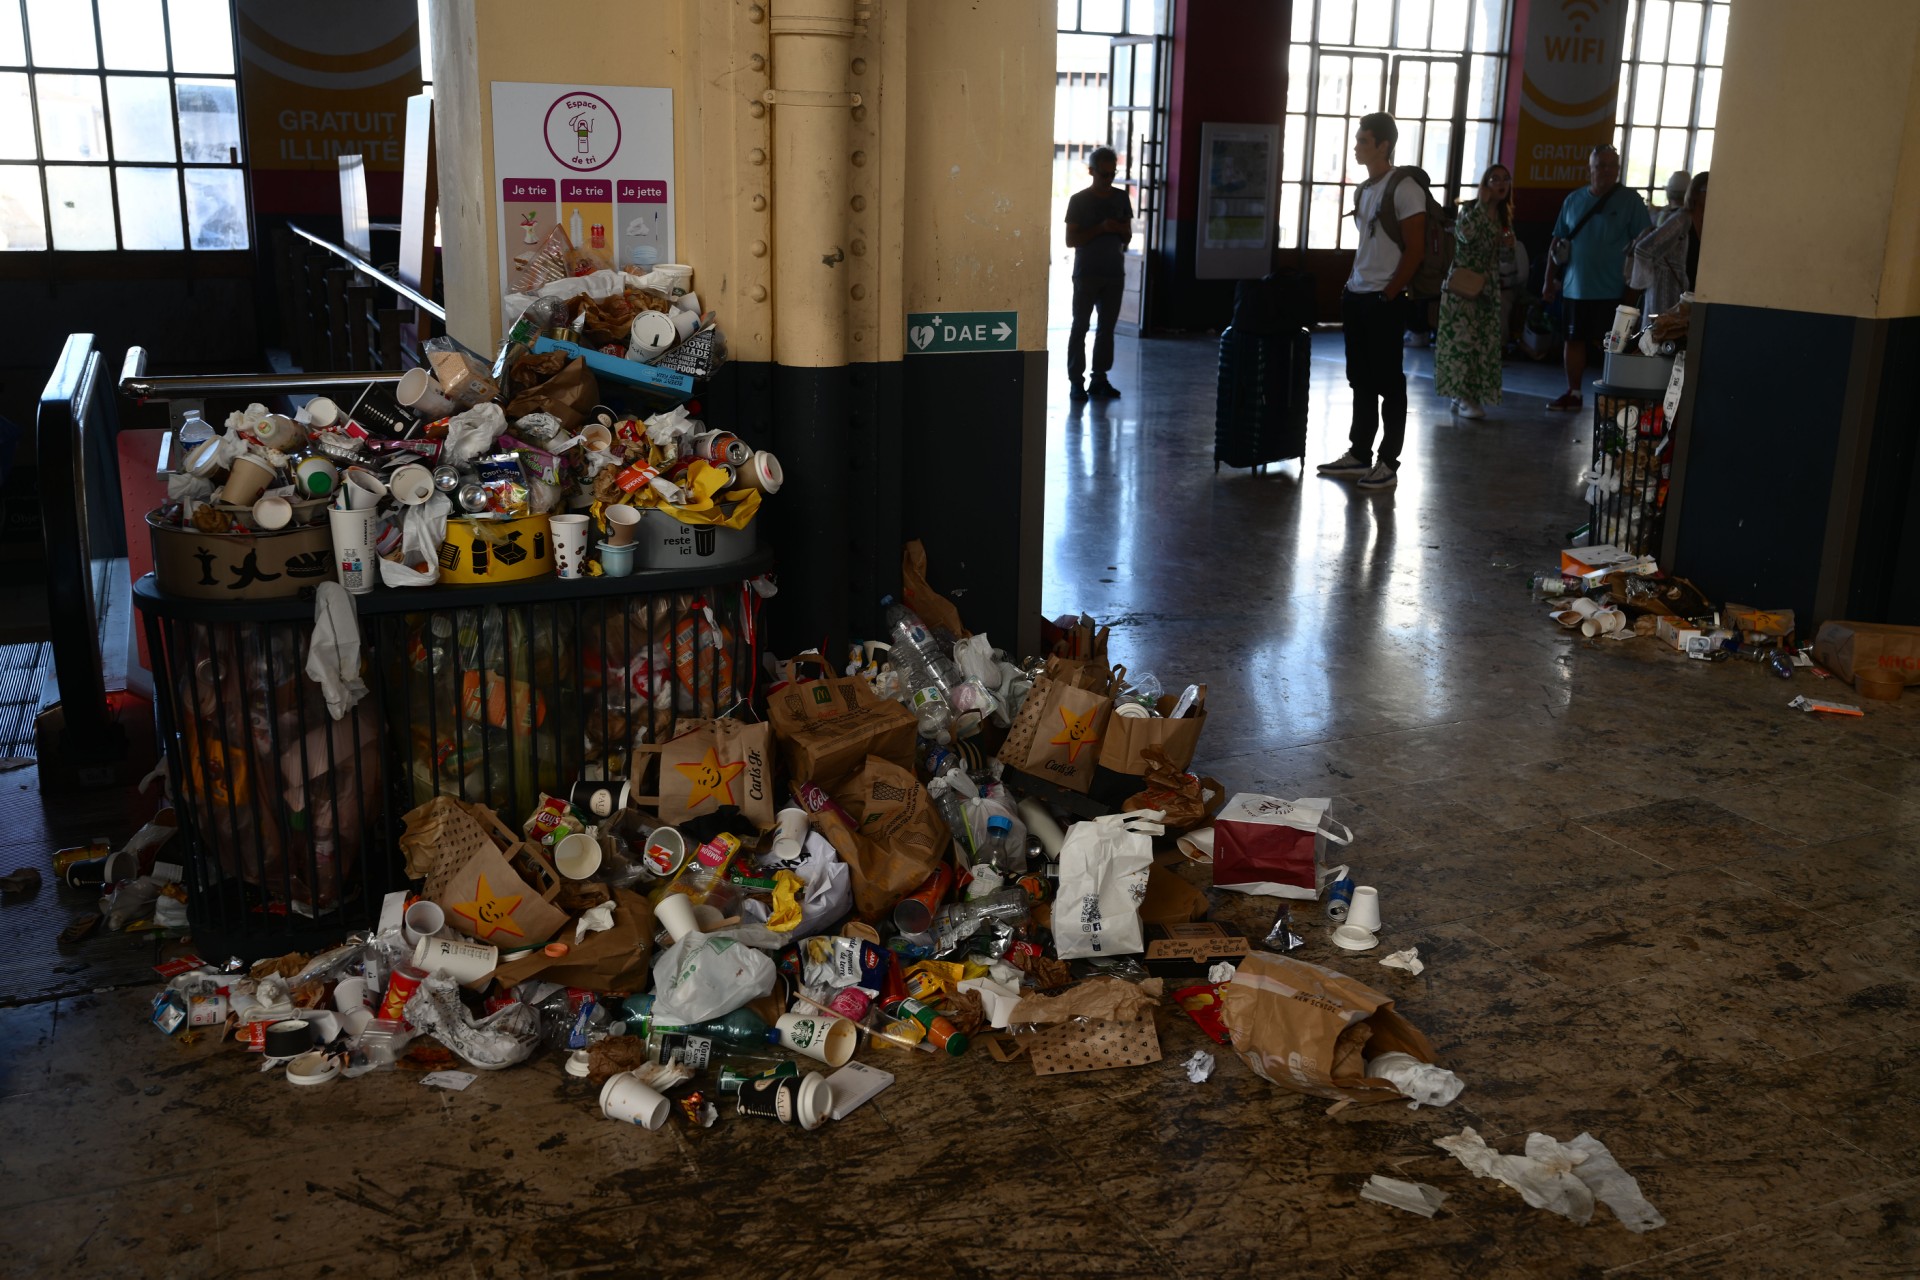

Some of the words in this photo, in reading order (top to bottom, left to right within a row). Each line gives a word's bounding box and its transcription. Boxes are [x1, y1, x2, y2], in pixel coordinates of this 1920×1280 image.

[566, 100, 597, 110] Espace
[277, 110, 397, 133] GRATUIT
[280, 135, 400, 161] ILLIMITÉ
[571, 156, 583, 164] de
[585, 155, 596, 164] tri
[512, 185, 525, 195] Je
[528, 185, 547, 195] trie
[569, 185, 583, 196] Je
[585, 186, 604, 196] trie
[622, 186, 635, 196] Je
[637, 187, 662, 199] jette
[943, 324, 987, 342] DAE
[680, 347, 710, 359] MADE
[676, 364, 696, 374] FOOD
[481, 468, 521, 479] Capri-Sun
[680, 525, 690, 535] le
[663, 536, 691, 545] reste
[680, 546, 692, 555] ici
[748, 750, 762, 767] Jr.
[1044, 759, 1067, 775] Carl's
[749, 767, 763, 801] Carl's
[598, 792, 607, 815] PAUL
[699, 846, 723, 862] JAMBON
[839, 952, 846, 962] de
[846, 949, 854, 976] pommes
[777, 1090, 786, 1119] PAUL
